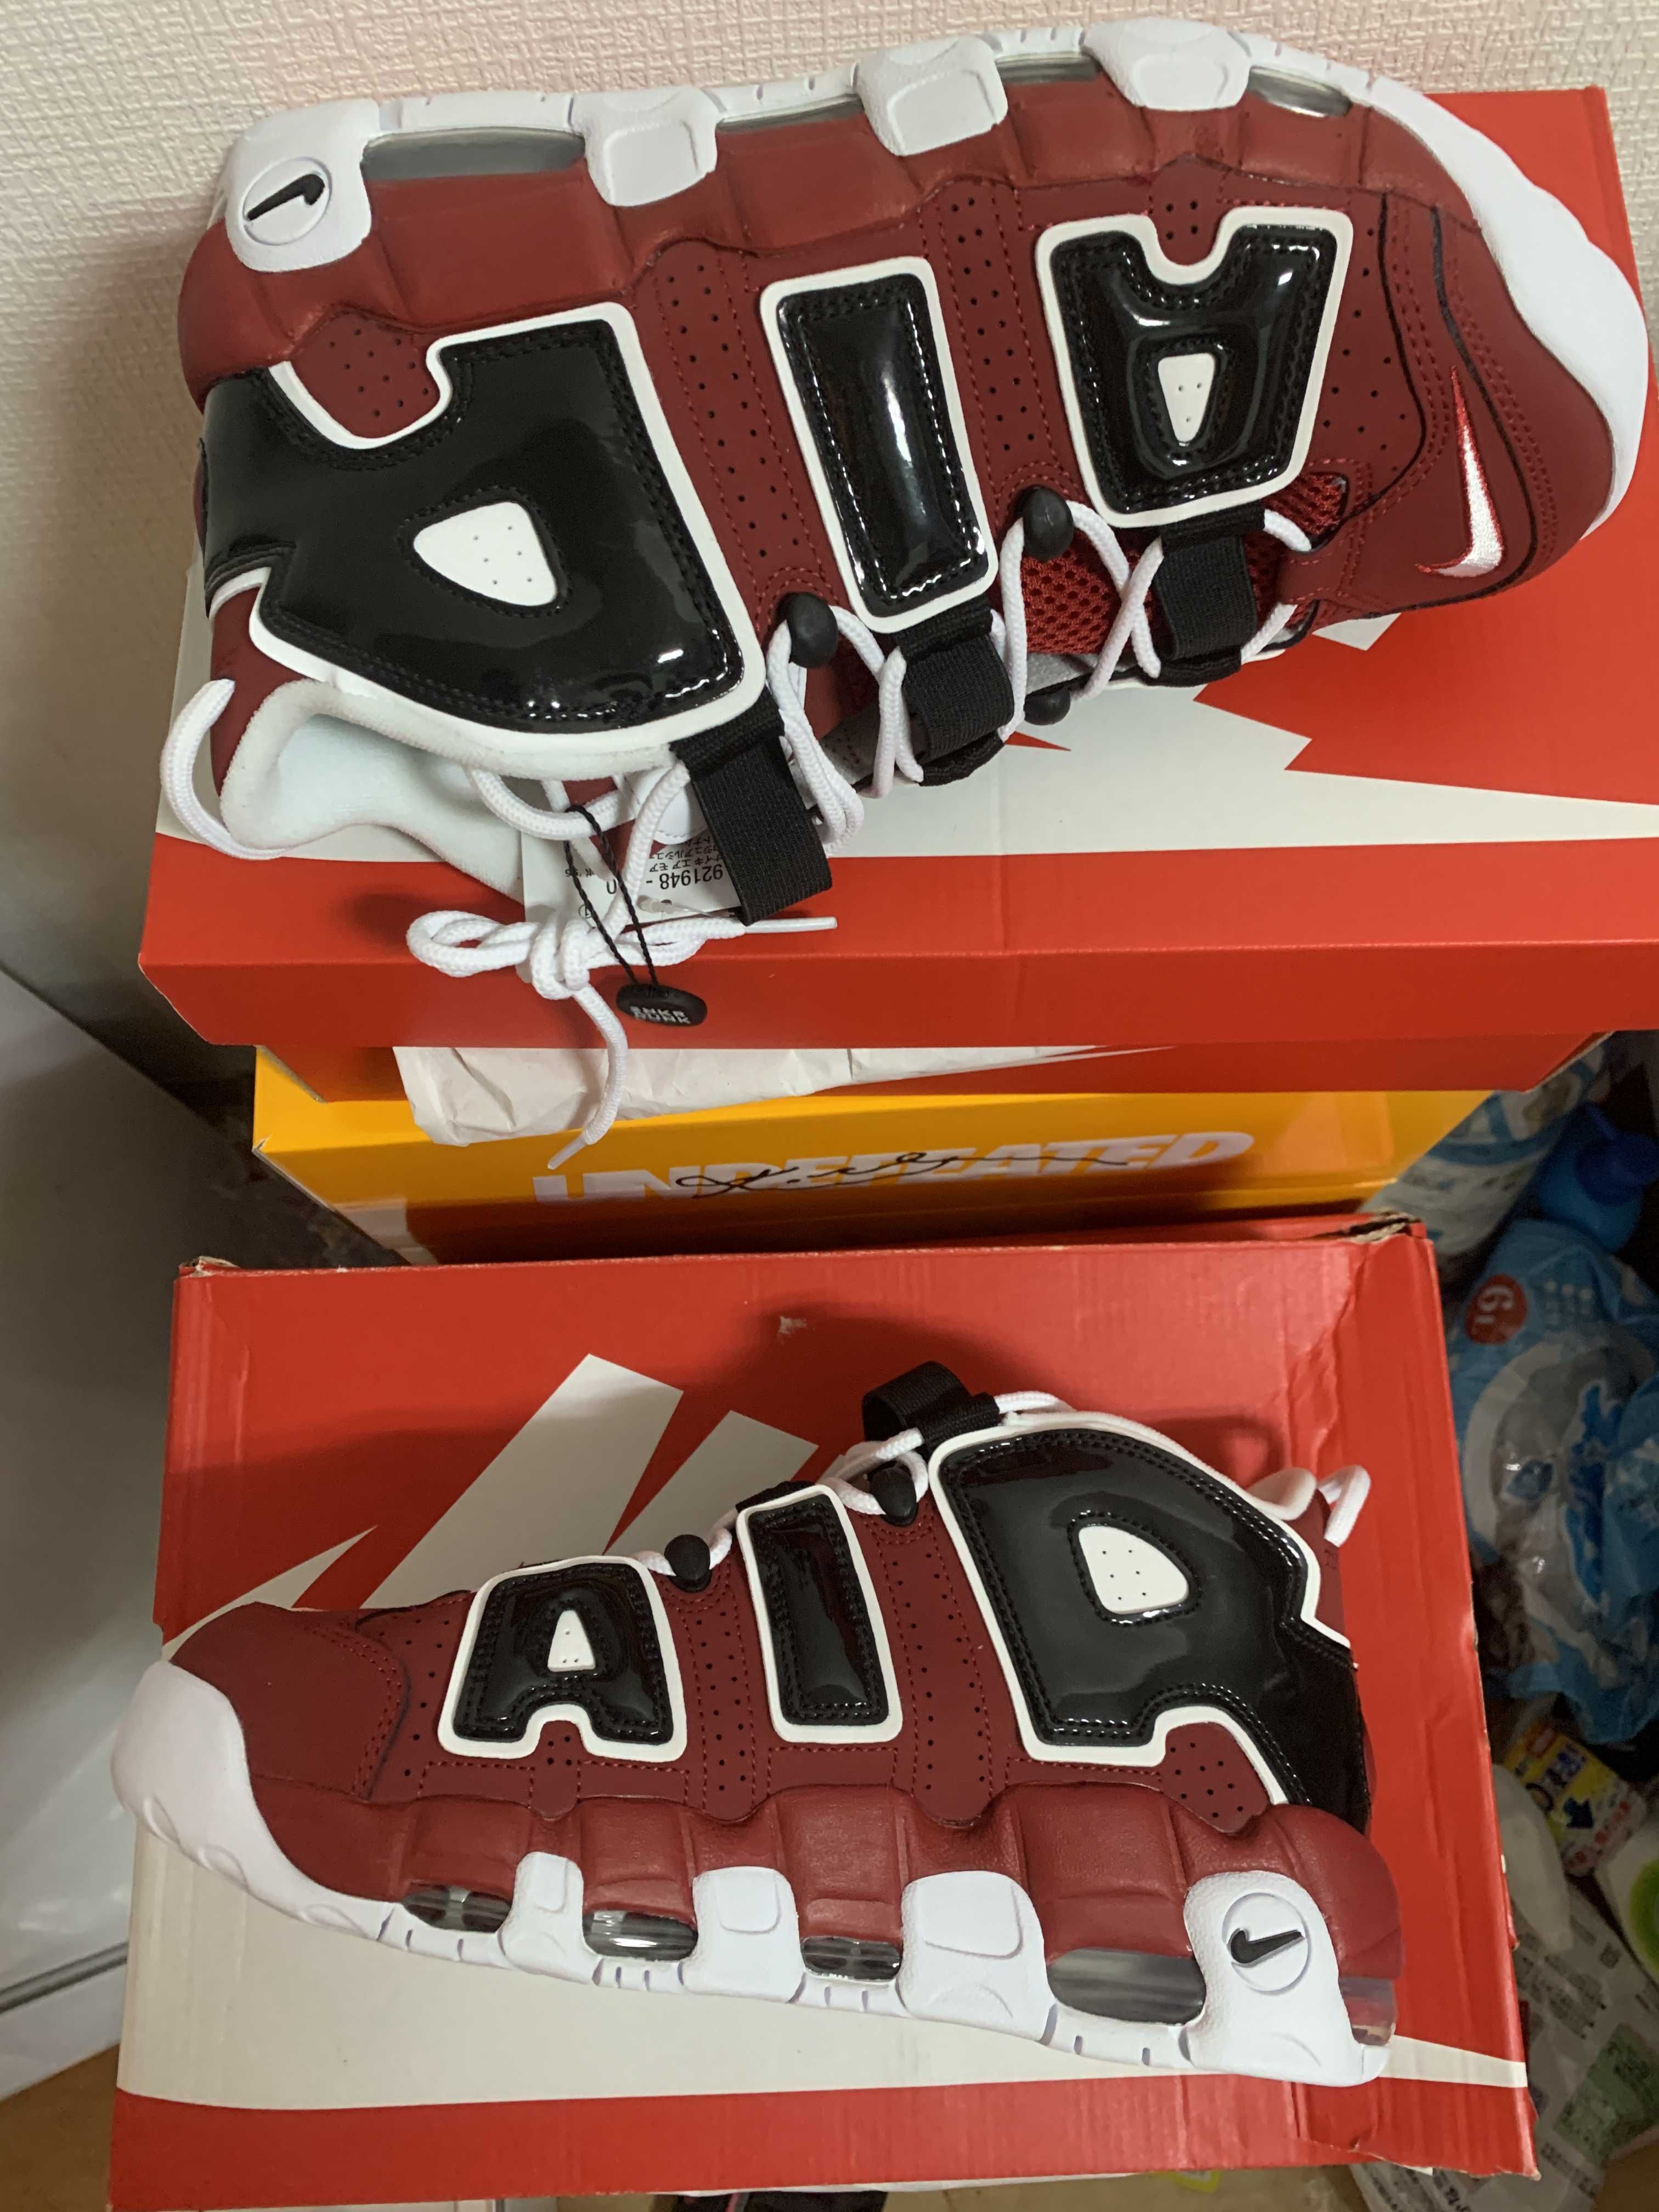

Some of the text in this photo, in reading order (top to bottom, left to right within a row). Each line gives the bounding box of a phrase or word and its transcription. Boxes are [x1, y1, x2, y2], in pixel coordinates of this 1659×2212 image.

[659, 864, 724, 890] 921948
[672, 859, 691, 870] エア
[532, 1131, 1255, 1205] UNDEFEATED
